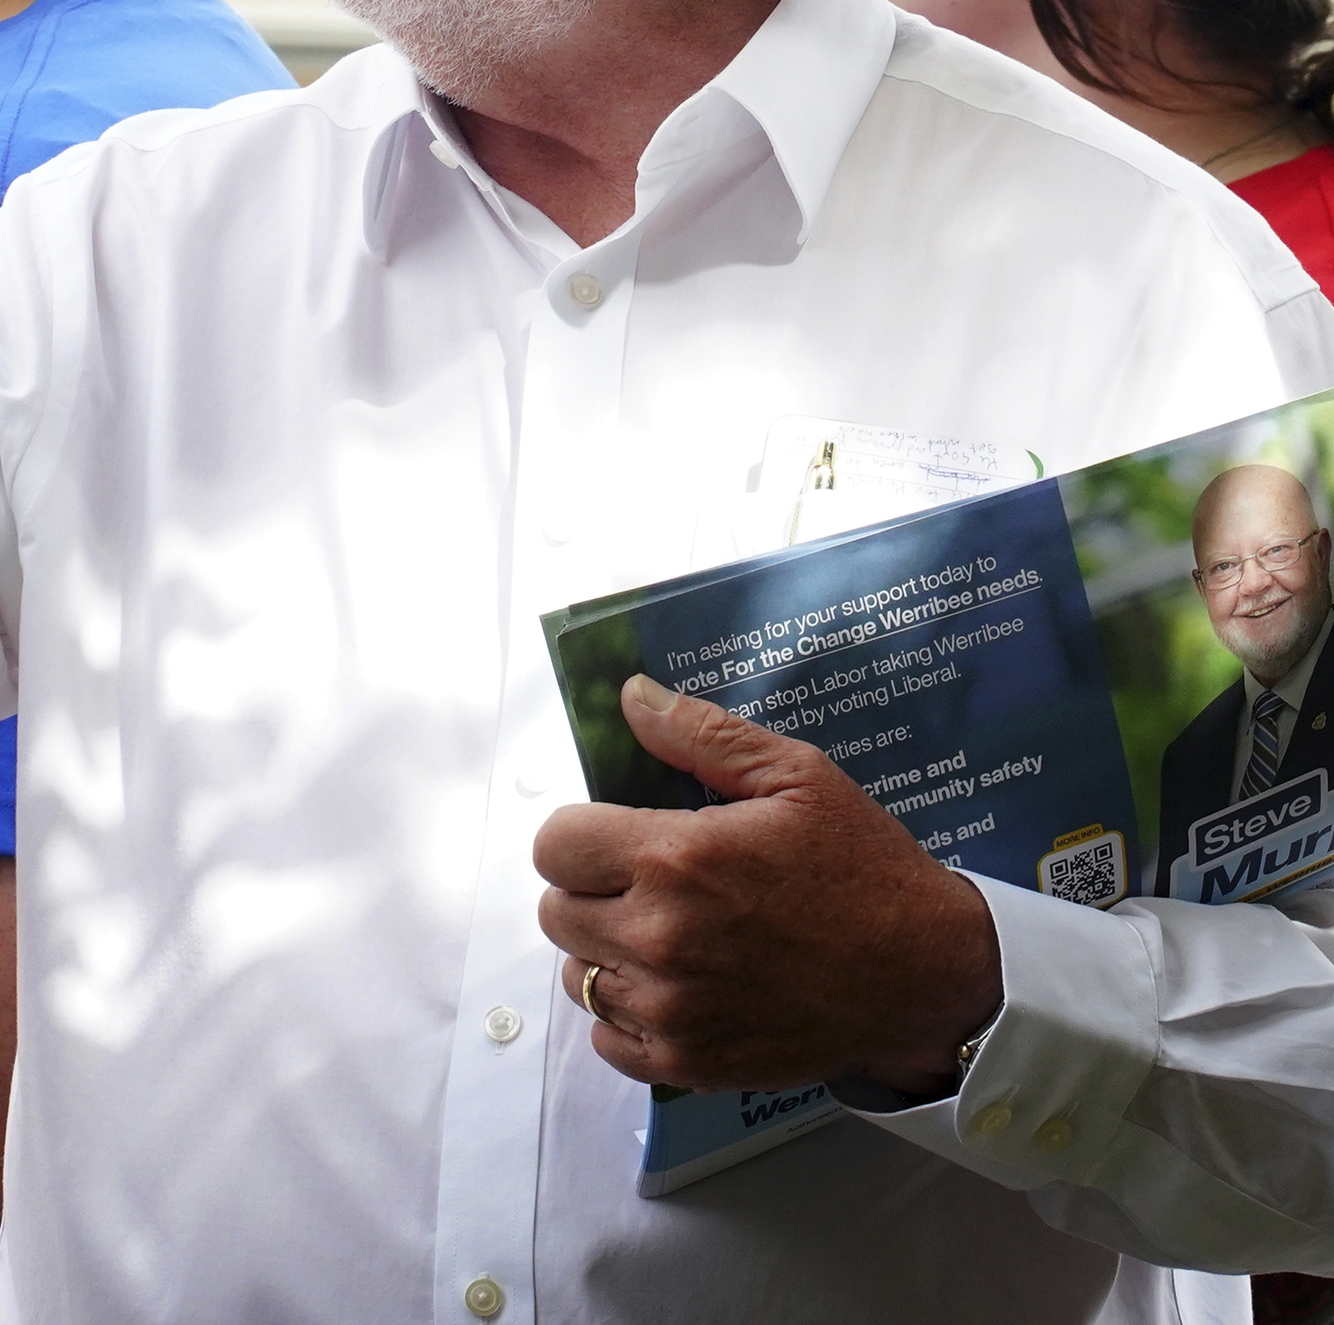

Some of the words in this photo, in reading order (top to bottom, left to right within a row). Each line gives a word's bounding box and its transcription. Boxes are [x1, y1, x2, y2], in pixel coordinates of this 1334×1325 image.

[666, 651, 696, 671] I'm
[699, 628, 764, 660] asking
[764, 618, 792, 641] for
[793, 604, 838, 636] your
[840, 579, 919, 617] support
[919, 561, 974, 595] today
[976, 554, 998, 575] to
[674, 669, 720, 696] vote
[722, 658, 756, 681] For
[759, 643, 795, 669] the
[796, 619, 878, 658] Change
[877, 587, 974, 630] Werribee
[976, 566, 1045, 600] needs.
[765, 685, 810, 711] stop
[811, 663, 869, 695] Labor
[871, 642, 934, 679] taking
[932, 615, 1026, 659] Werribee
[800, 705, 825, 726] by
[827, 682, 891, 716] voting
[890, 661, 963, 696] Liberal.
[824, 733, 873, 761] rities
[875, 723, 915, 748] are:
[861, 768, 922, 797] crime
[926, 749, 967, 778] and
[885, 777, 976, 816] mmunity
[979, 753, 1045, 788] safety
[955, 811, 997, 841] and
[1056, 833, 1080, 847] MORE
[1081, 826, 1101, 839] INFO
[1203, 790, 1313, 856] Steve
